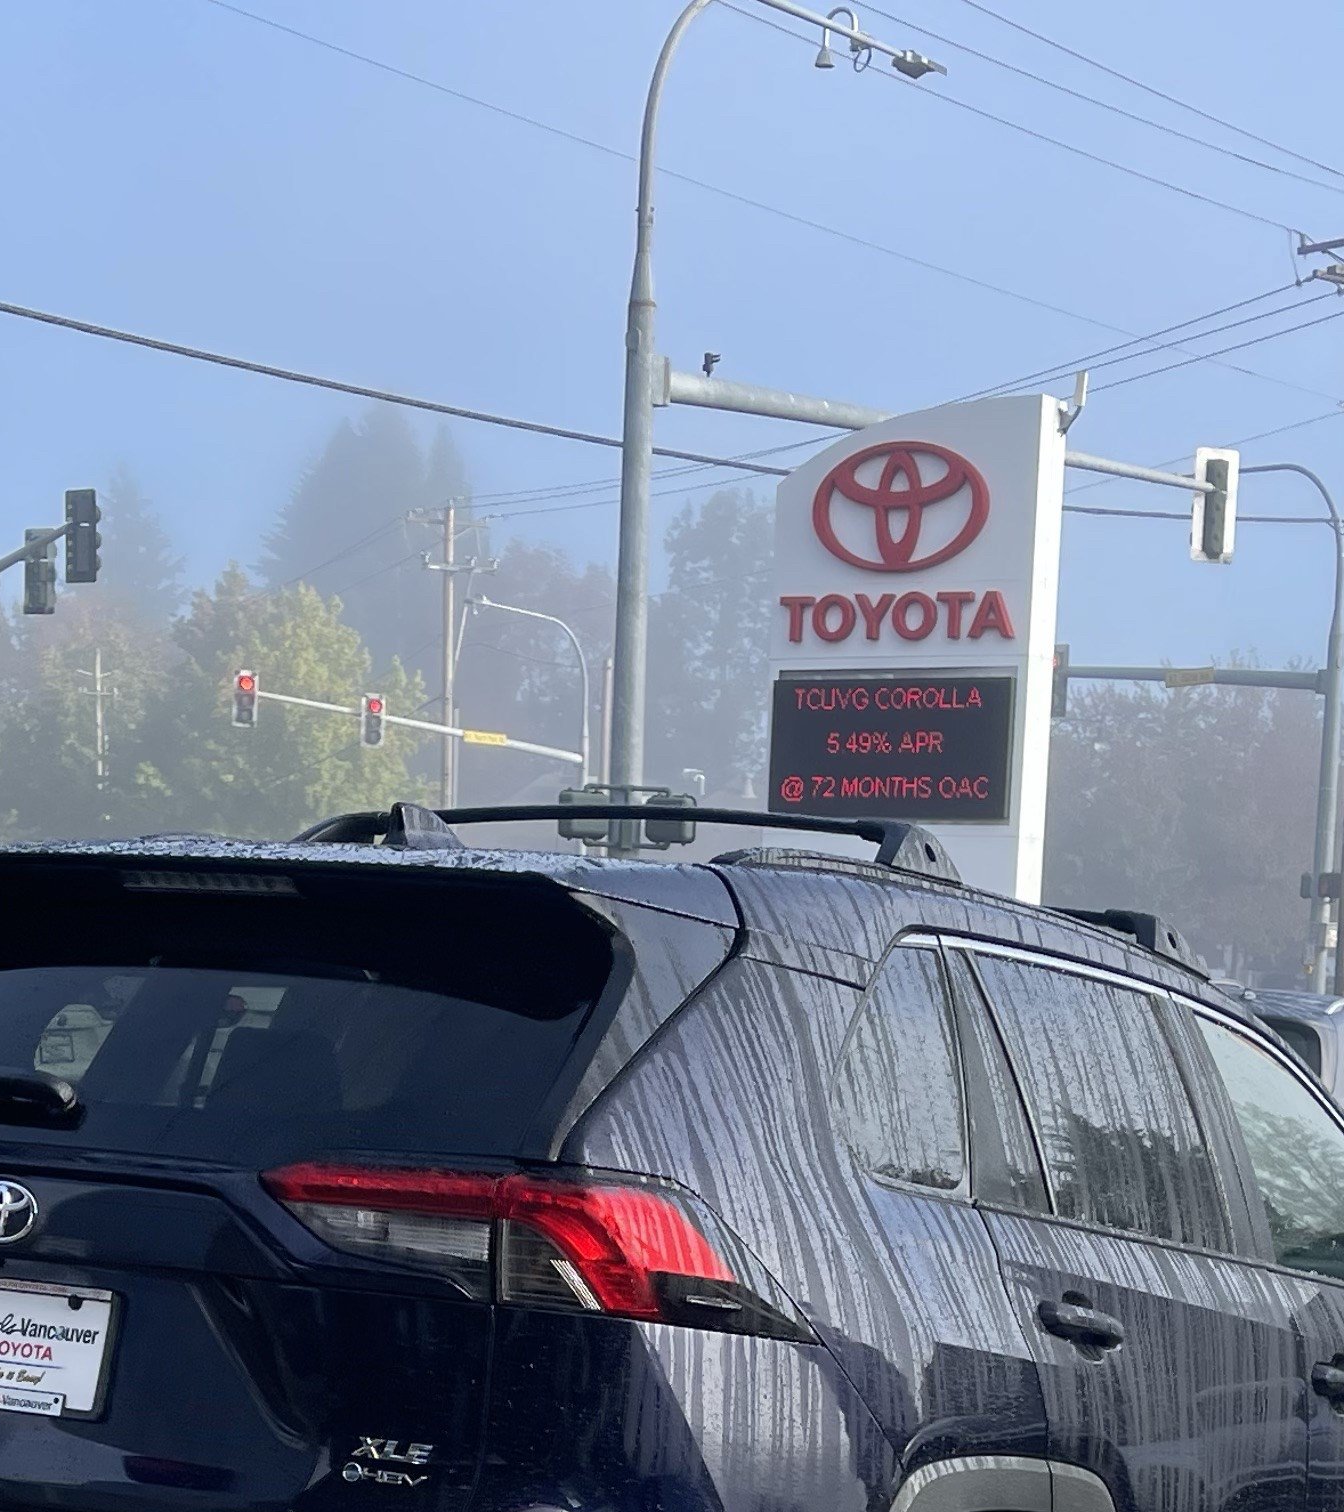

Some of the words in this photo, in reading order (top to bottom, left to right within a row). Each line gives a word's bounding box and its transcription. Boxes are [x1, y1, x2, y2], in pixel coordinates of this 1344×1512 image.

[780, 590, 1016, 642] TOYOTA
[875, 686, 983, 711] COROLLA
[827, 730, 892, 754] 549%
[898, 731, 944, 754] APR
[780, 775, 805, 801] @
[811, 776, 836, 798] 72
[840, 776, 933, 799] MONTHS
[351, 1436, 434, 1465] XLE
